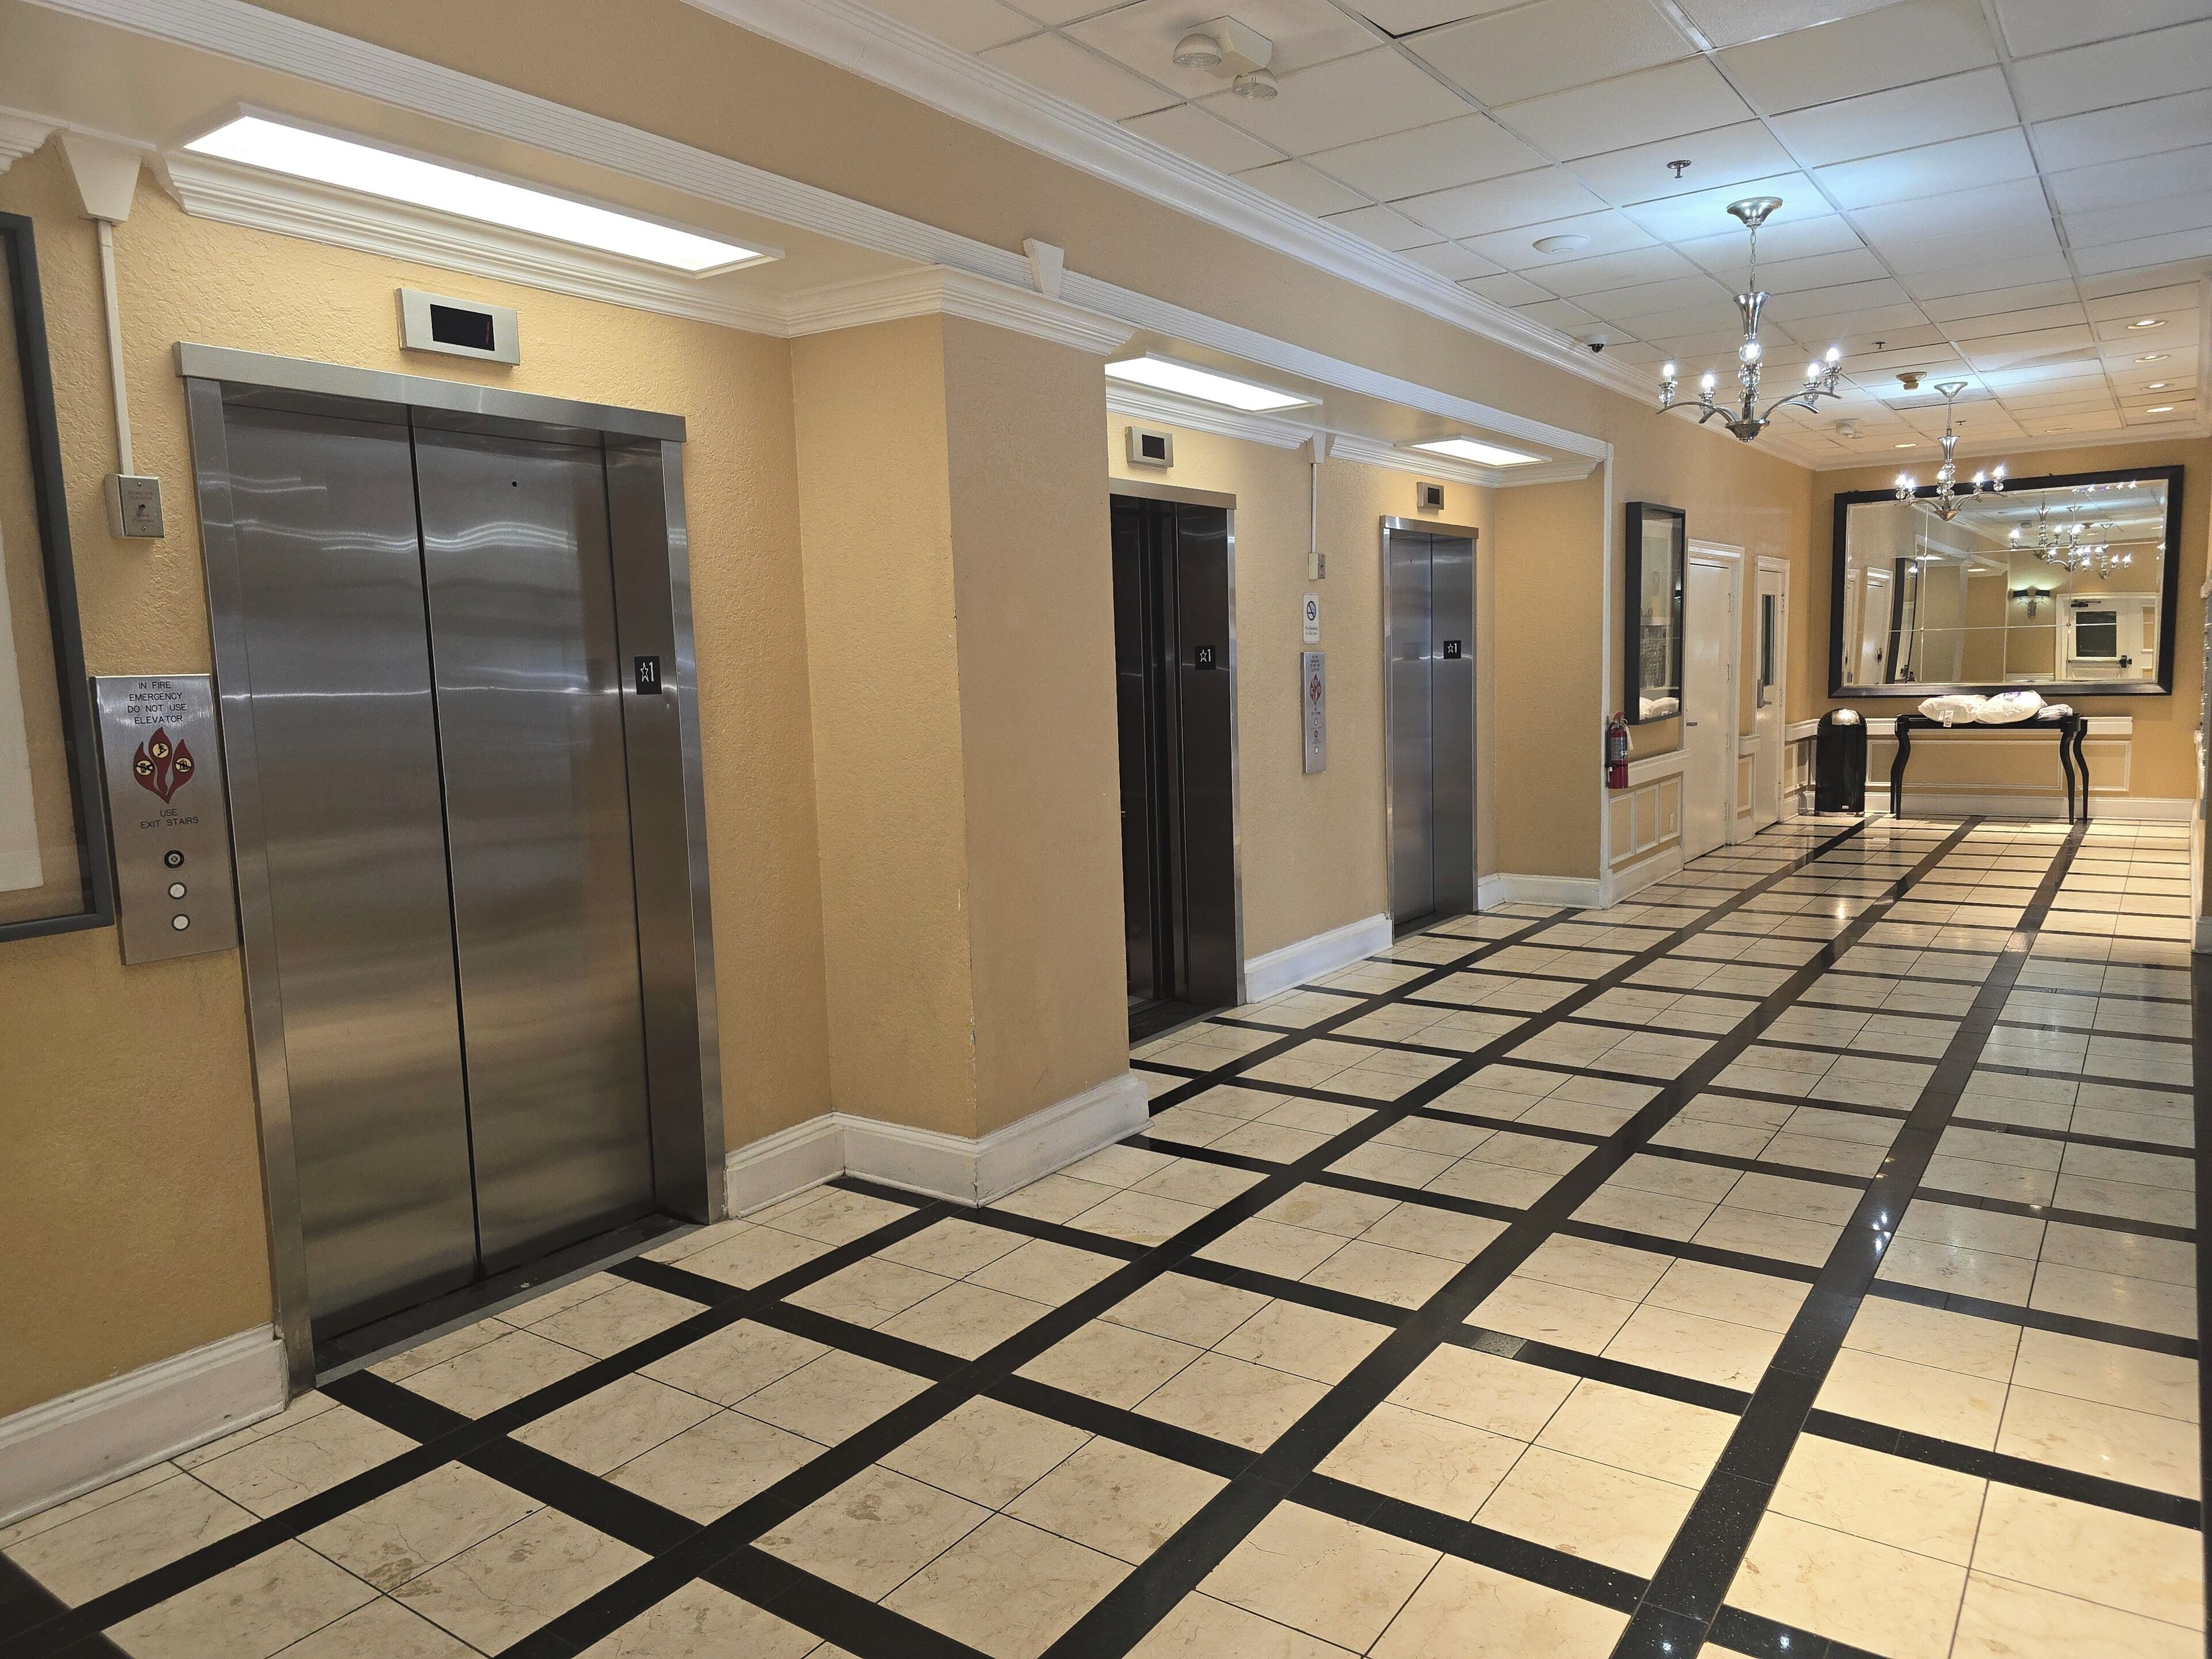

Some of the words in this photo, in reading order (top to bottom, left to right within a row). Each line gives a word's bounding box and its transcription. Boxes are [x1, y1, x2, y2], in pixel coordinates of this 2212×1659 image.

[129, 692, 183, 701] EMERGENCY
[127, 705, 140, 713] DO
[169, 703, 187, 711] USE
[134, 715, 183, 724] ELEVATOR
[160, 808, 178, 817] USE
[140, 820, 160, 829] EXIT
[166, 816, 199, 827] STAIRS
